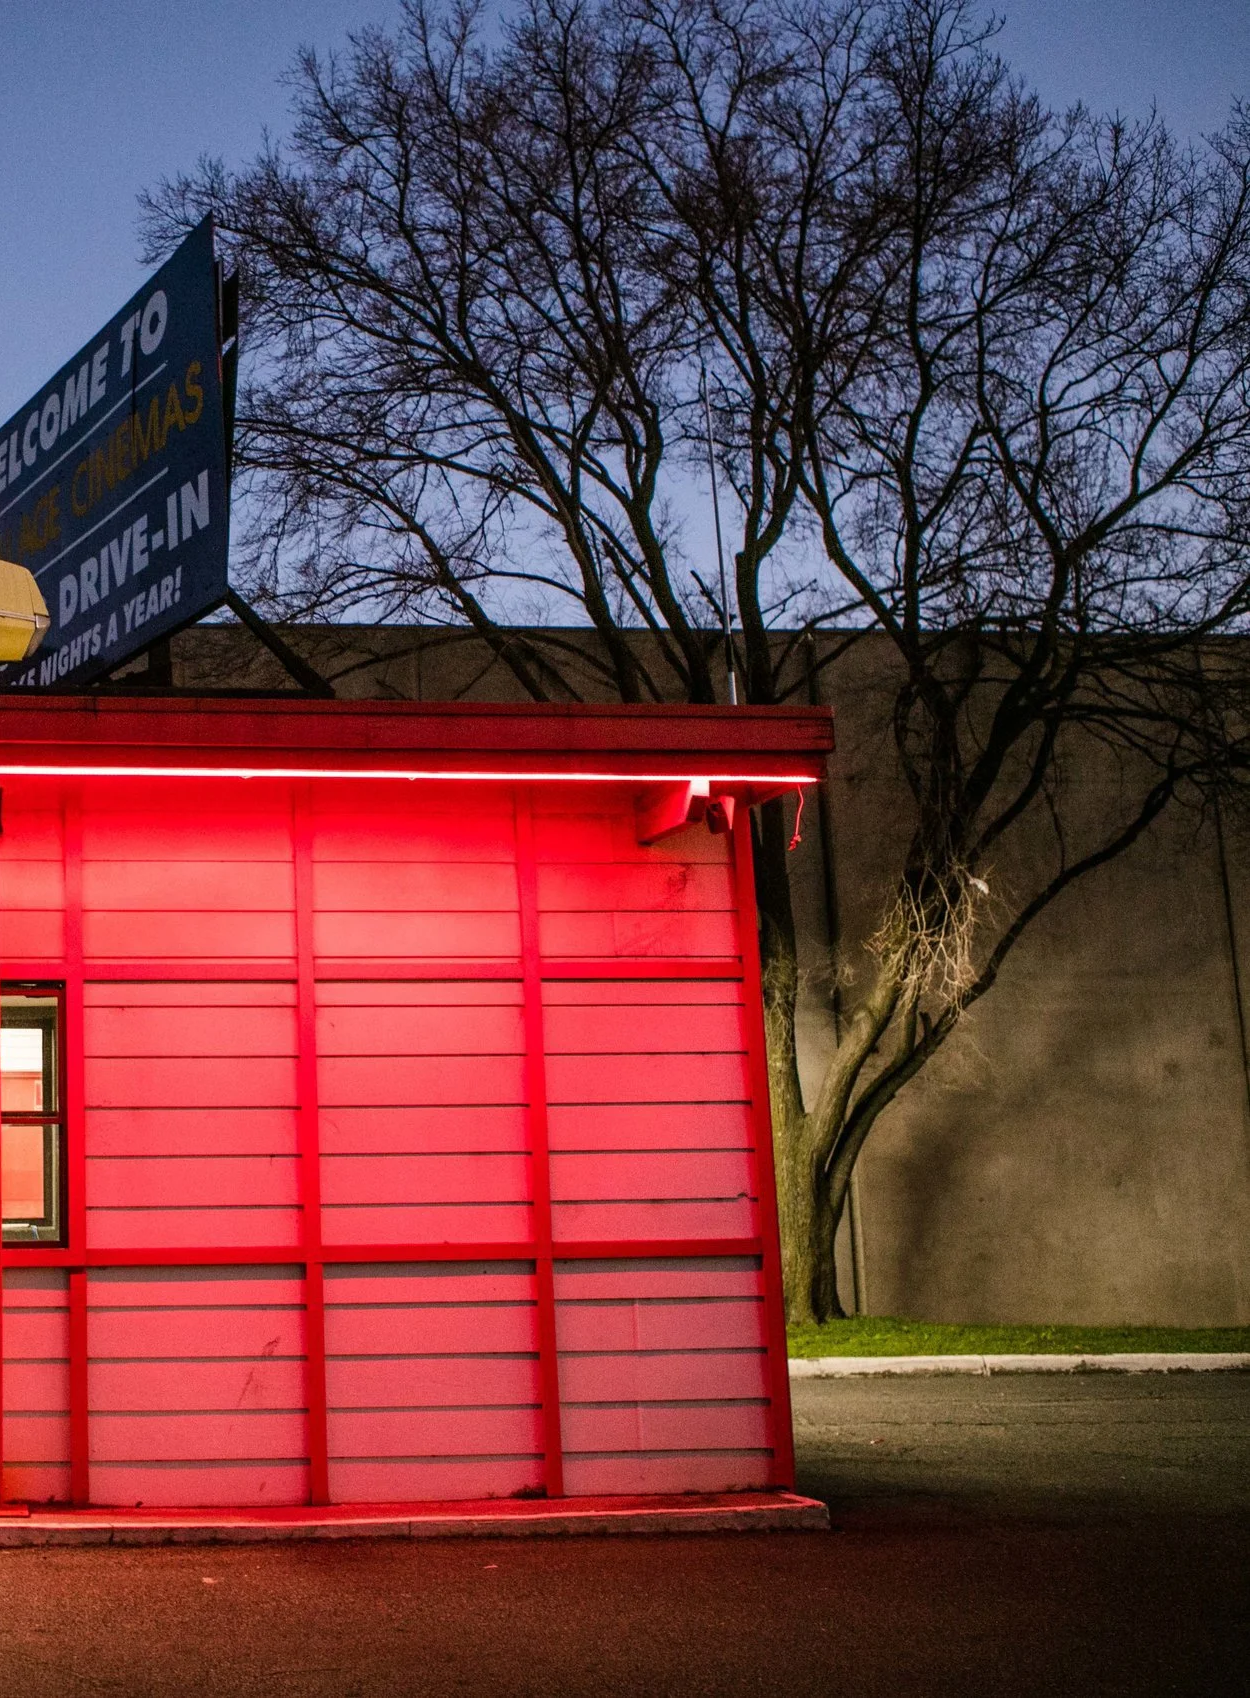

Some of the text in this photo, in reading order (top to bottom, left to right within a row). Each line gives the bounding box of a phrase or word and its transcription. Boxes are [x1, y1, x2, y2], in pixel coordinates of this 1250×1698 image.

[120, 290, 168, 375] TO
[71, 360, 204, 518] CINEMAS
[59, 469, 211, 628] DRIVE-IN
[40, 566, 182, 686] NIGHTS A YEAR!
